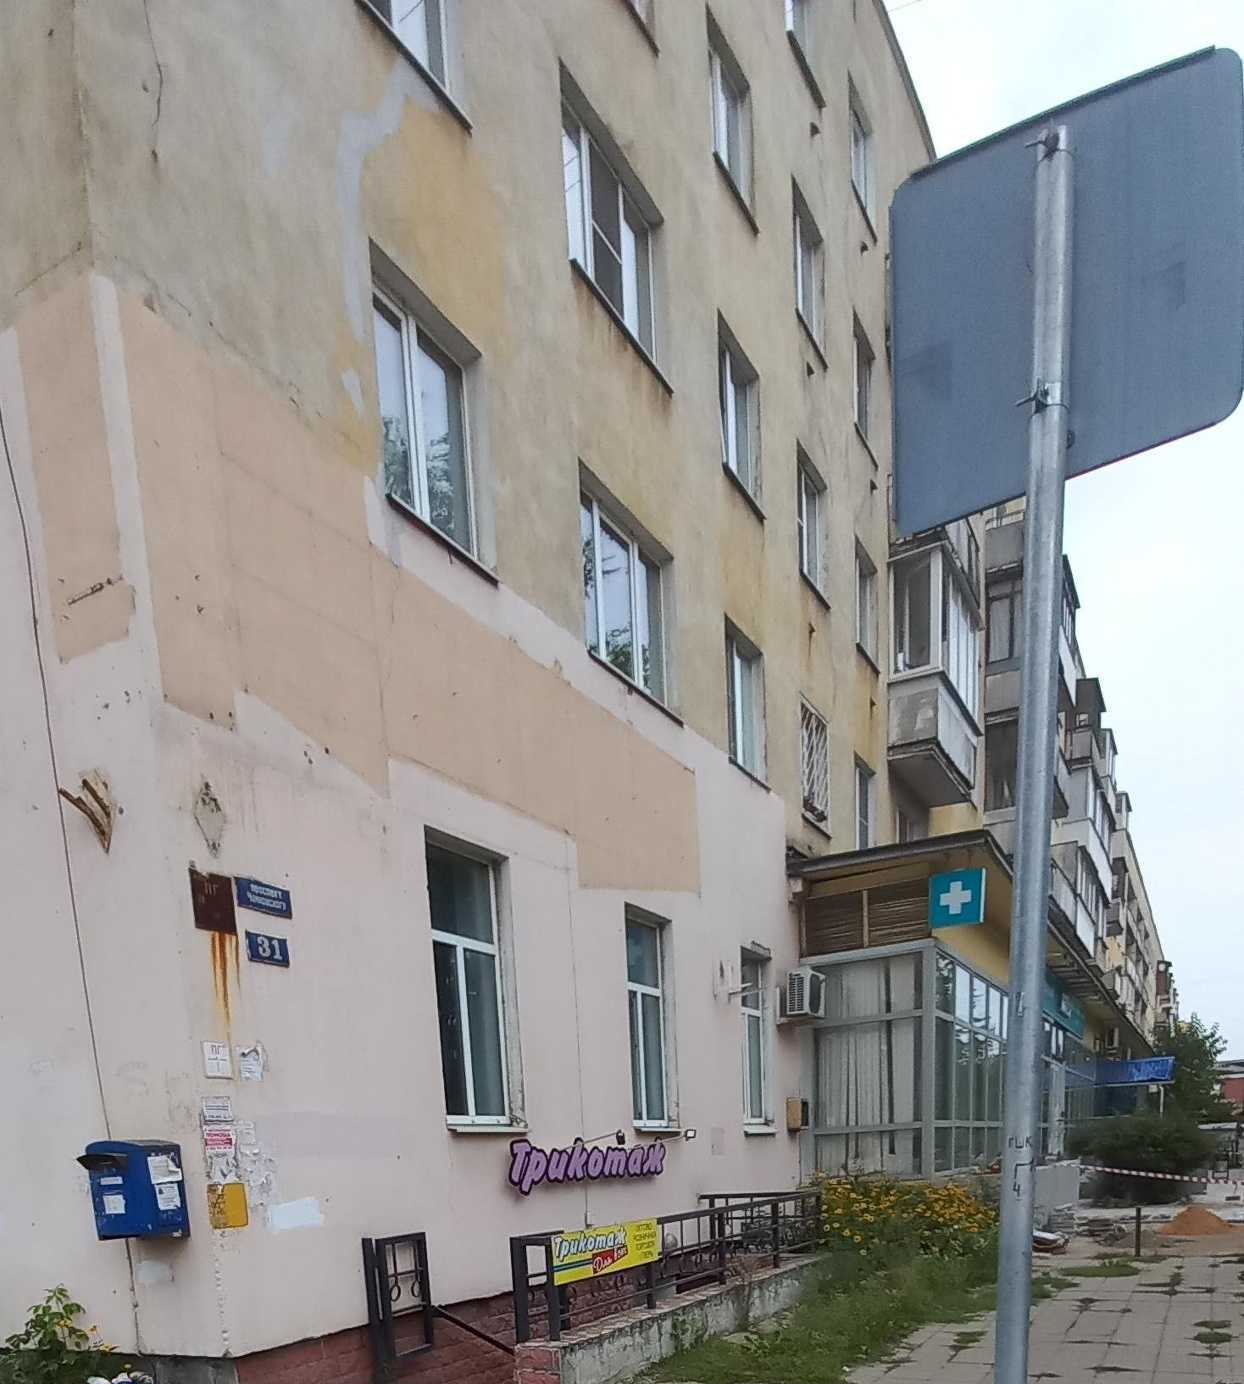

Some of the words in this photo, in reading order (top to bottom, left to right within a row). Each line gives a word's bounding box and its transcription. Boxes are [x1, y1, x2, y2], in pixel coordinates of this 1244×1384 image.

[257, 936, 283, 960] 31
[509, 1139, 665, 1195] Трикотаж
[554, 1225, 626, 1262] Трикотаж
